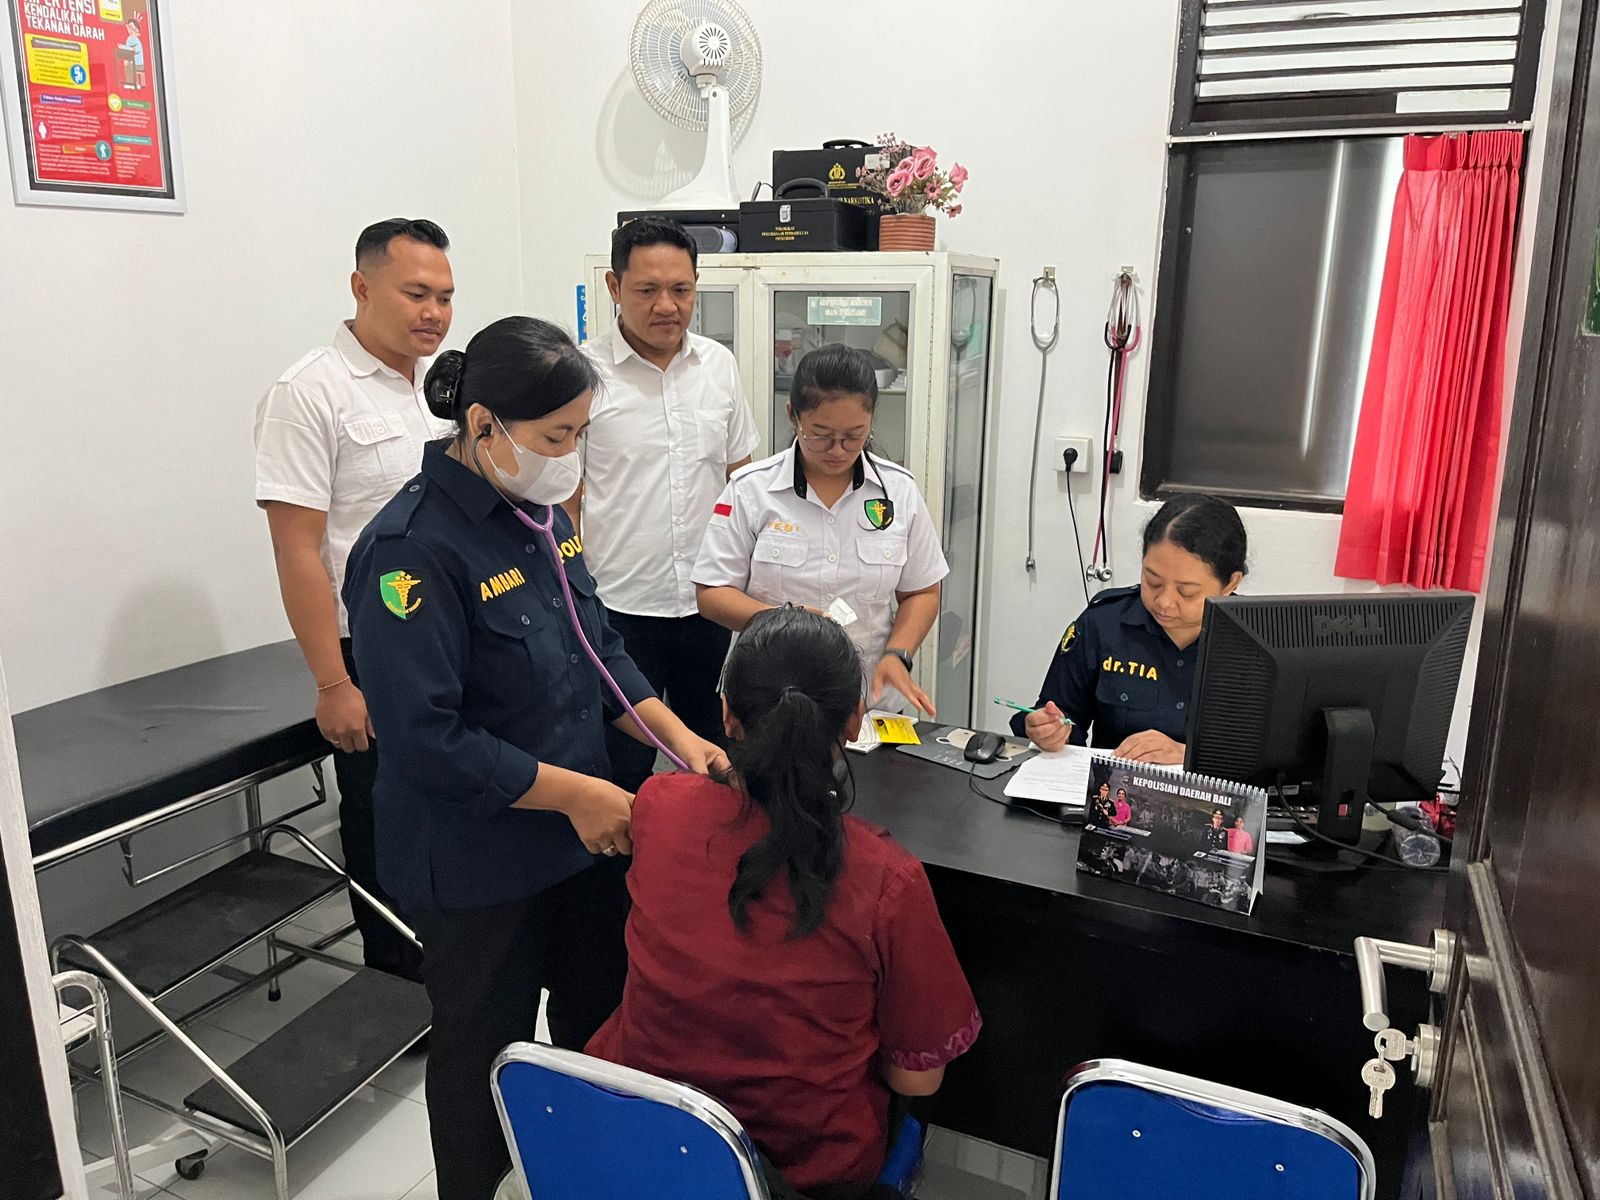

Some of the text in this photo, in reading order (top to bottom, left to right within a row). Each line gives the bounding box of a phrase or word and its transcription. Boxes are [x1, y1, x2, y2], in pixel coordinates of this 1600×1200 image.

[23, 2, 83, 24] KENDALIKAN
[25, 14, 105, 41] TEKANAN DARAH
[1133, 776, 1232, 807] KEPOLISIAN DAERAH BALI
